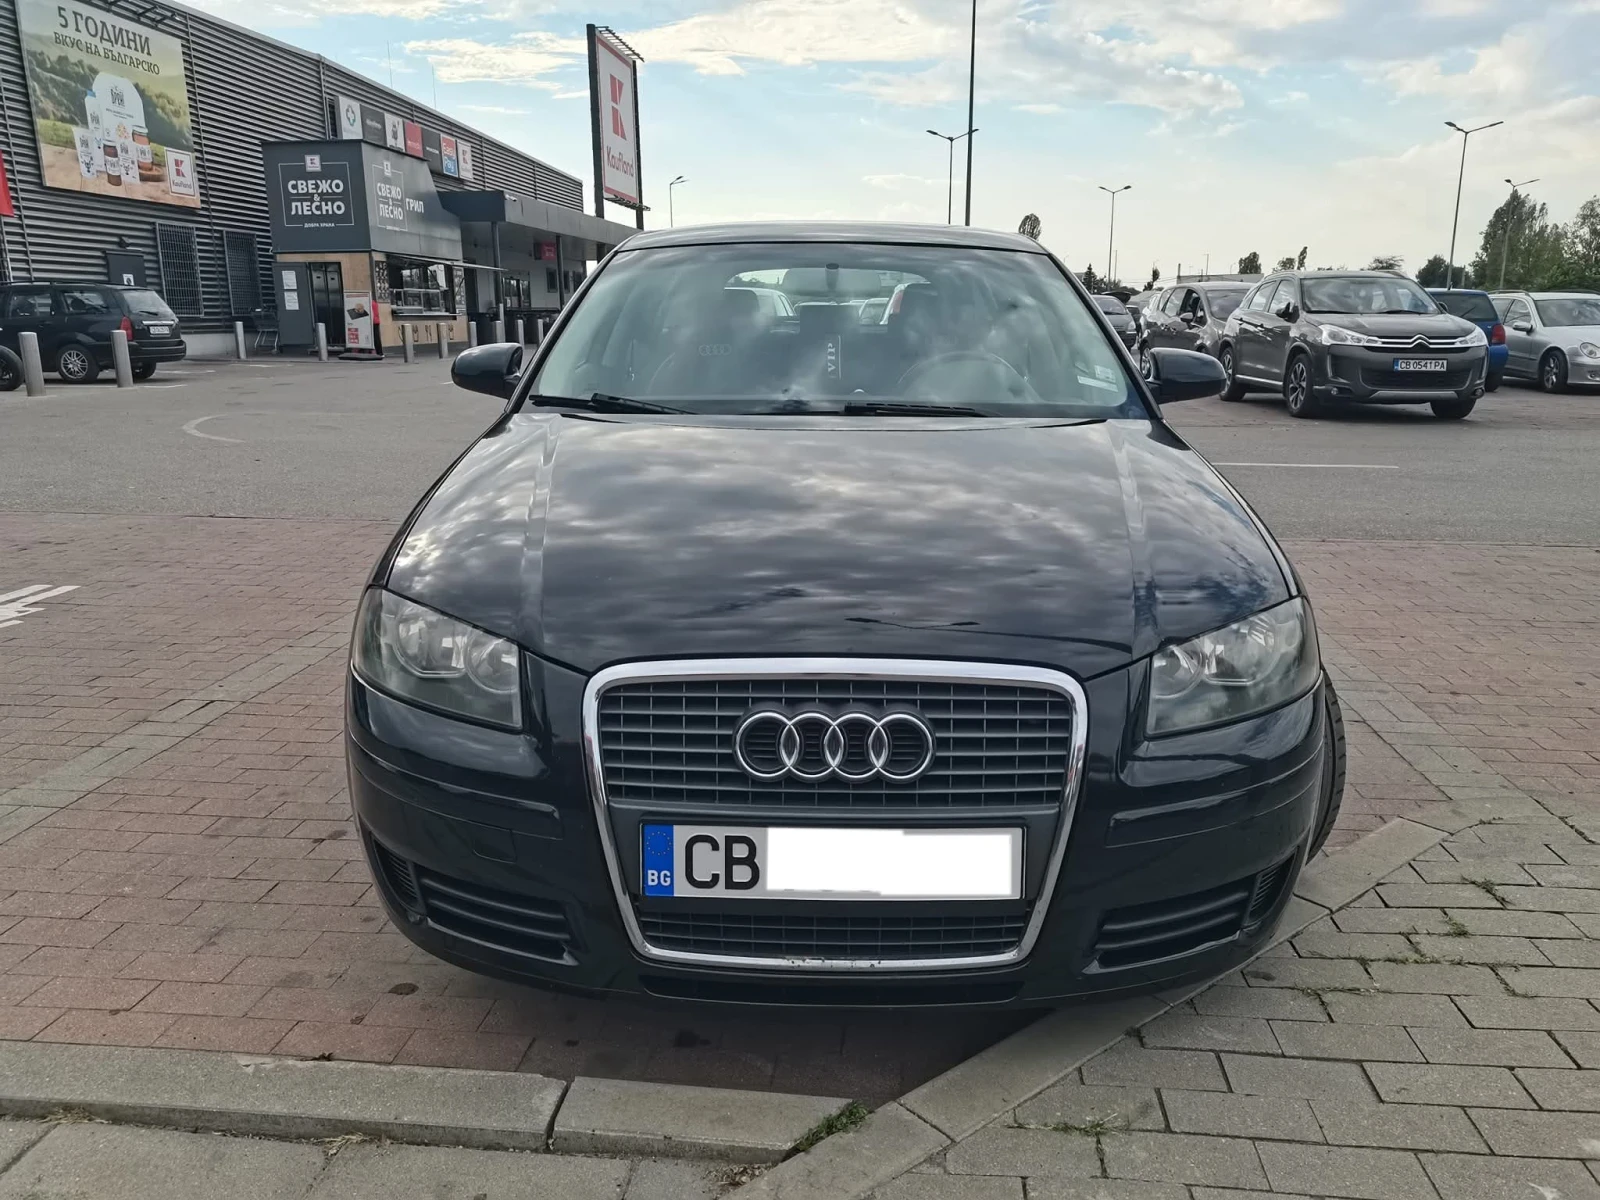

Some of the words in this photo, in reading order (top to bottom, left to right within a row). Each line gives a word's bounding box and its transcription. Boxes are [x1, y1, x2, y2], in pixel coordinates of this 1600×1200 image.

[57, 6, 69, 29] 5
[72, 10, 152, 57] ГОДИНИ
[53, 31, 83, 52] ВКУС
[84, 41, 102, 58] НА
[103, 47, 160, 76] БЪЛГАРСКО
[606, 145, 635, 178] Kaufland
[287, 179, 344, 194] СВЕЖО
[376, 182, 402, 200] СВЕЖО
[291, 201, 345, 215] ЛЕСНО
[379, 203, 404, 220] ЛЕСНО
[405, 198, 425, 213] ГРИЛ
[1399, 360, 1411, 370] CB
[684, 834, 760, 890] CB
[647, 869, 671, 887] BG
